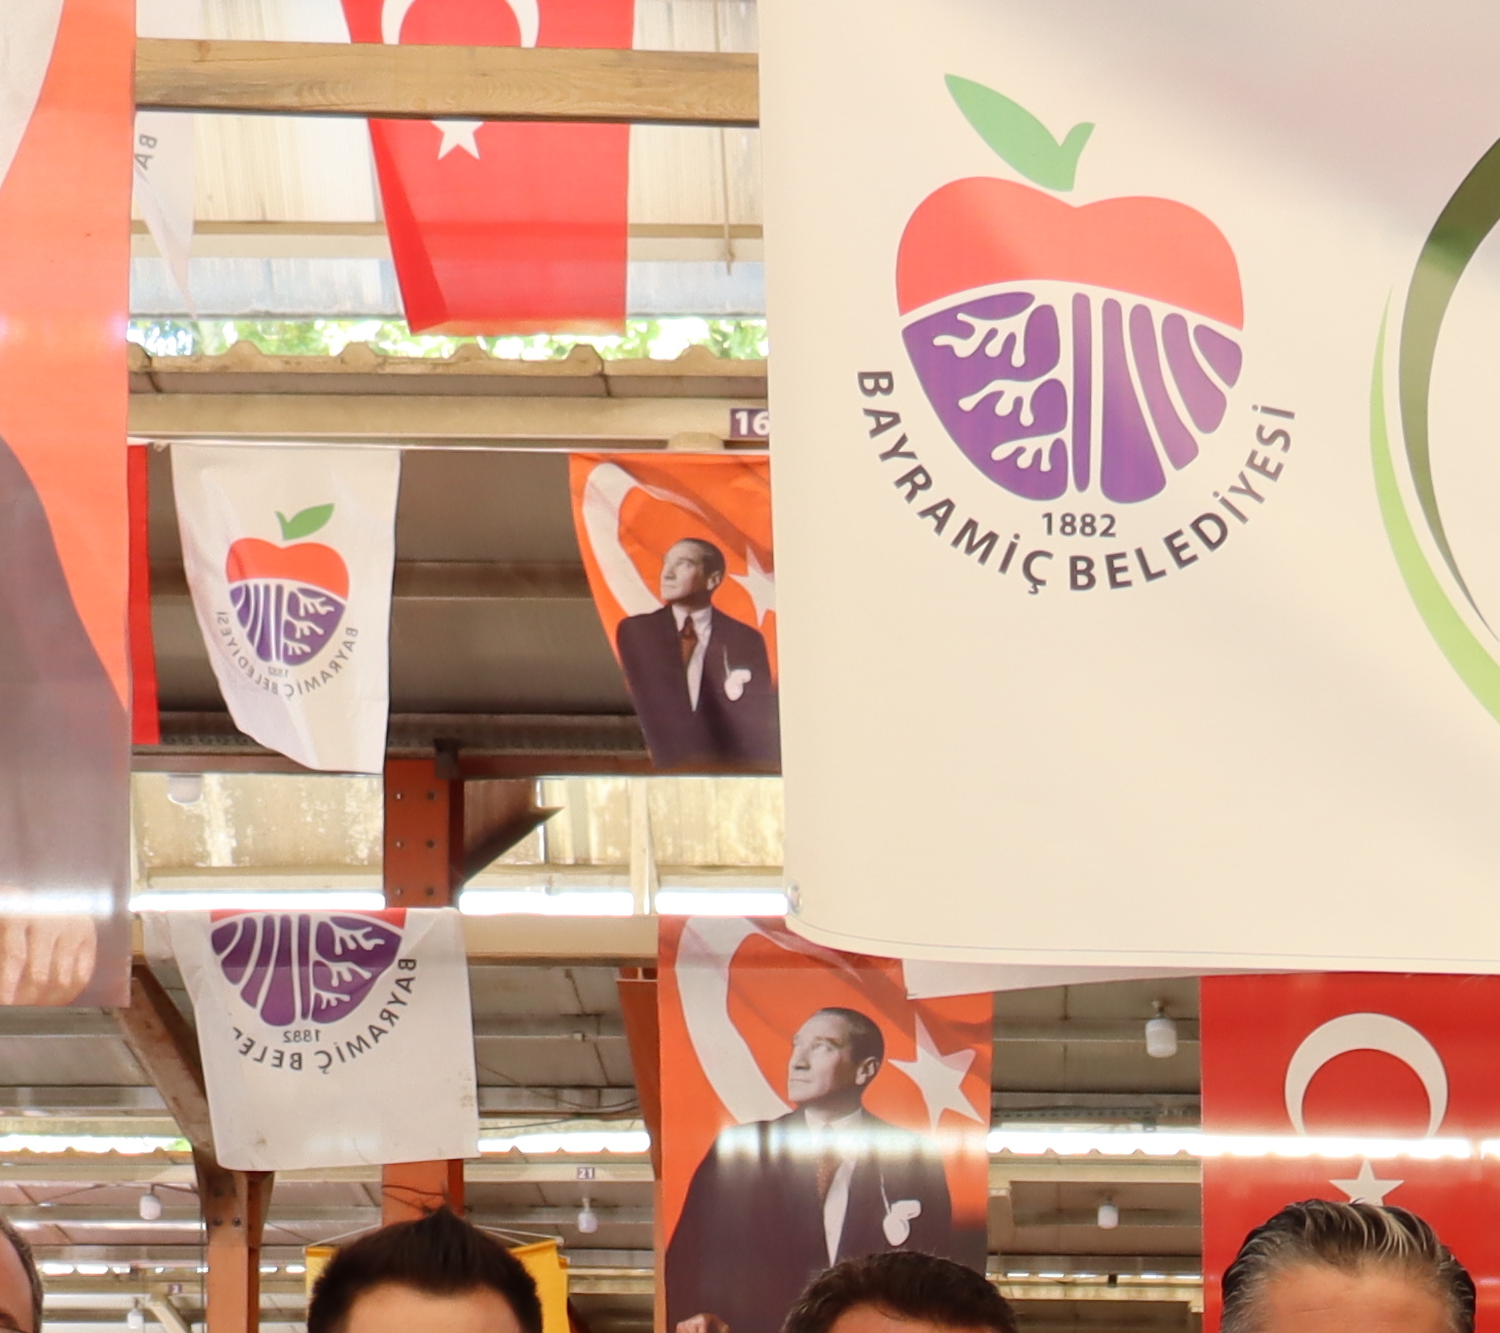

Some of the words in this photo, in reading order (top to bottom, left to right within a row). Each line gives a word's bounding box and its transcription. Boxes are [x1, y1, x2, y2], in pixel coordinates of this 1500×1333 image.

[857, 370, 1054, 596] BAYRAMİÇ
[1068, 403, 1297, 592] BELEDİYESİ
[1041, 512, 1118, 539] 1882
